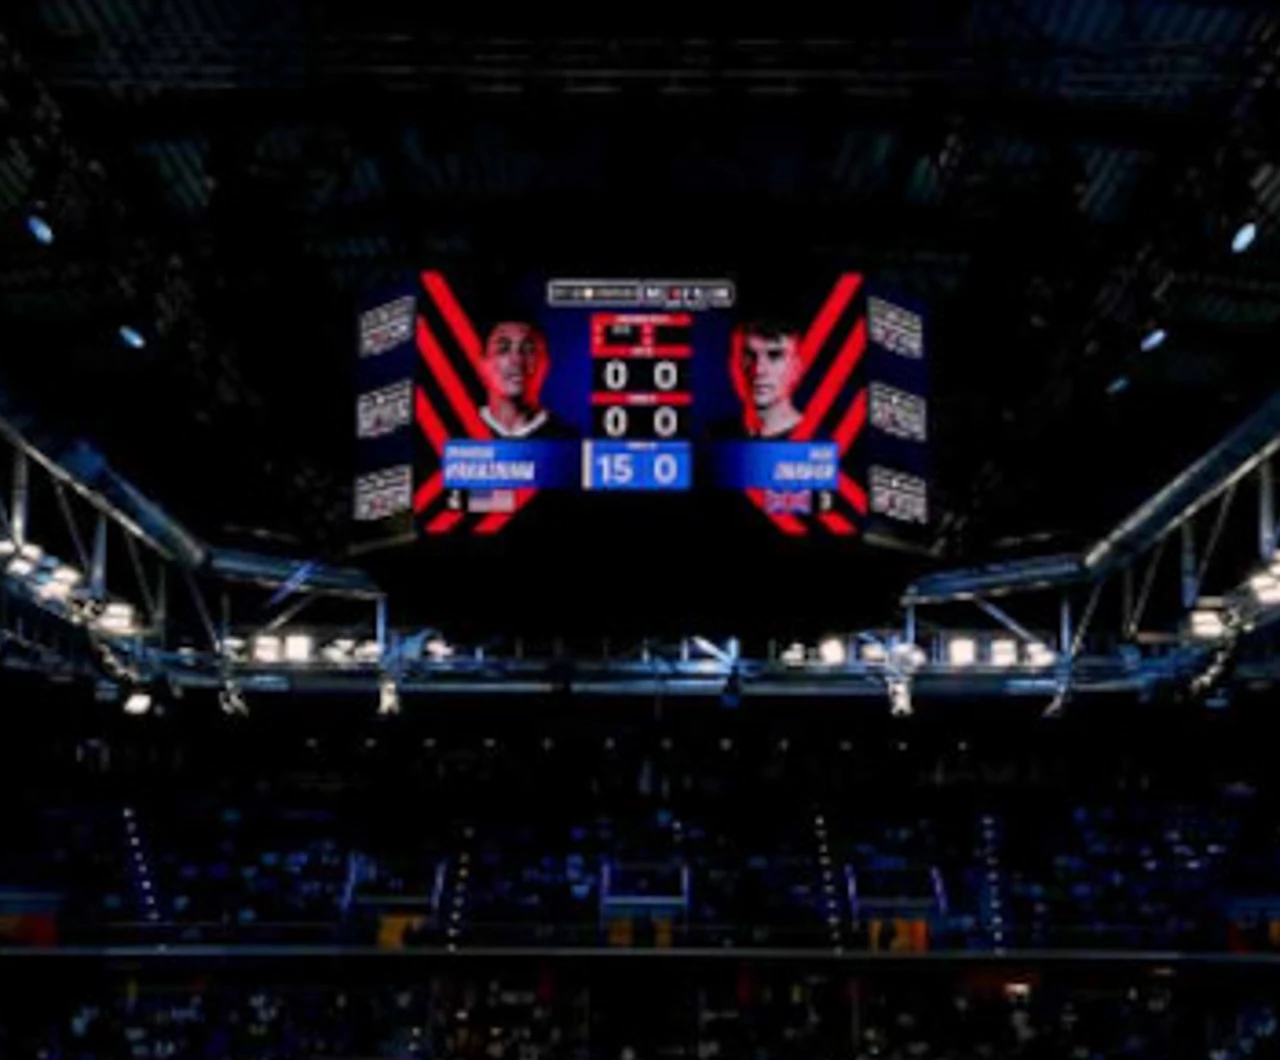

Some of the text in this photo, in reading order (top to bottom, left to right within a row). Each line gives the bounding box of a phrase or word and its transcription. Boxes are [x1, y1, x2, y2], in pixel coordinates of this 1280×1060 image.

[604, 360, 678, 391] 0 0
[604, 406, 678, 437] 0 0
[597, 454, 678, 482] 15 0
